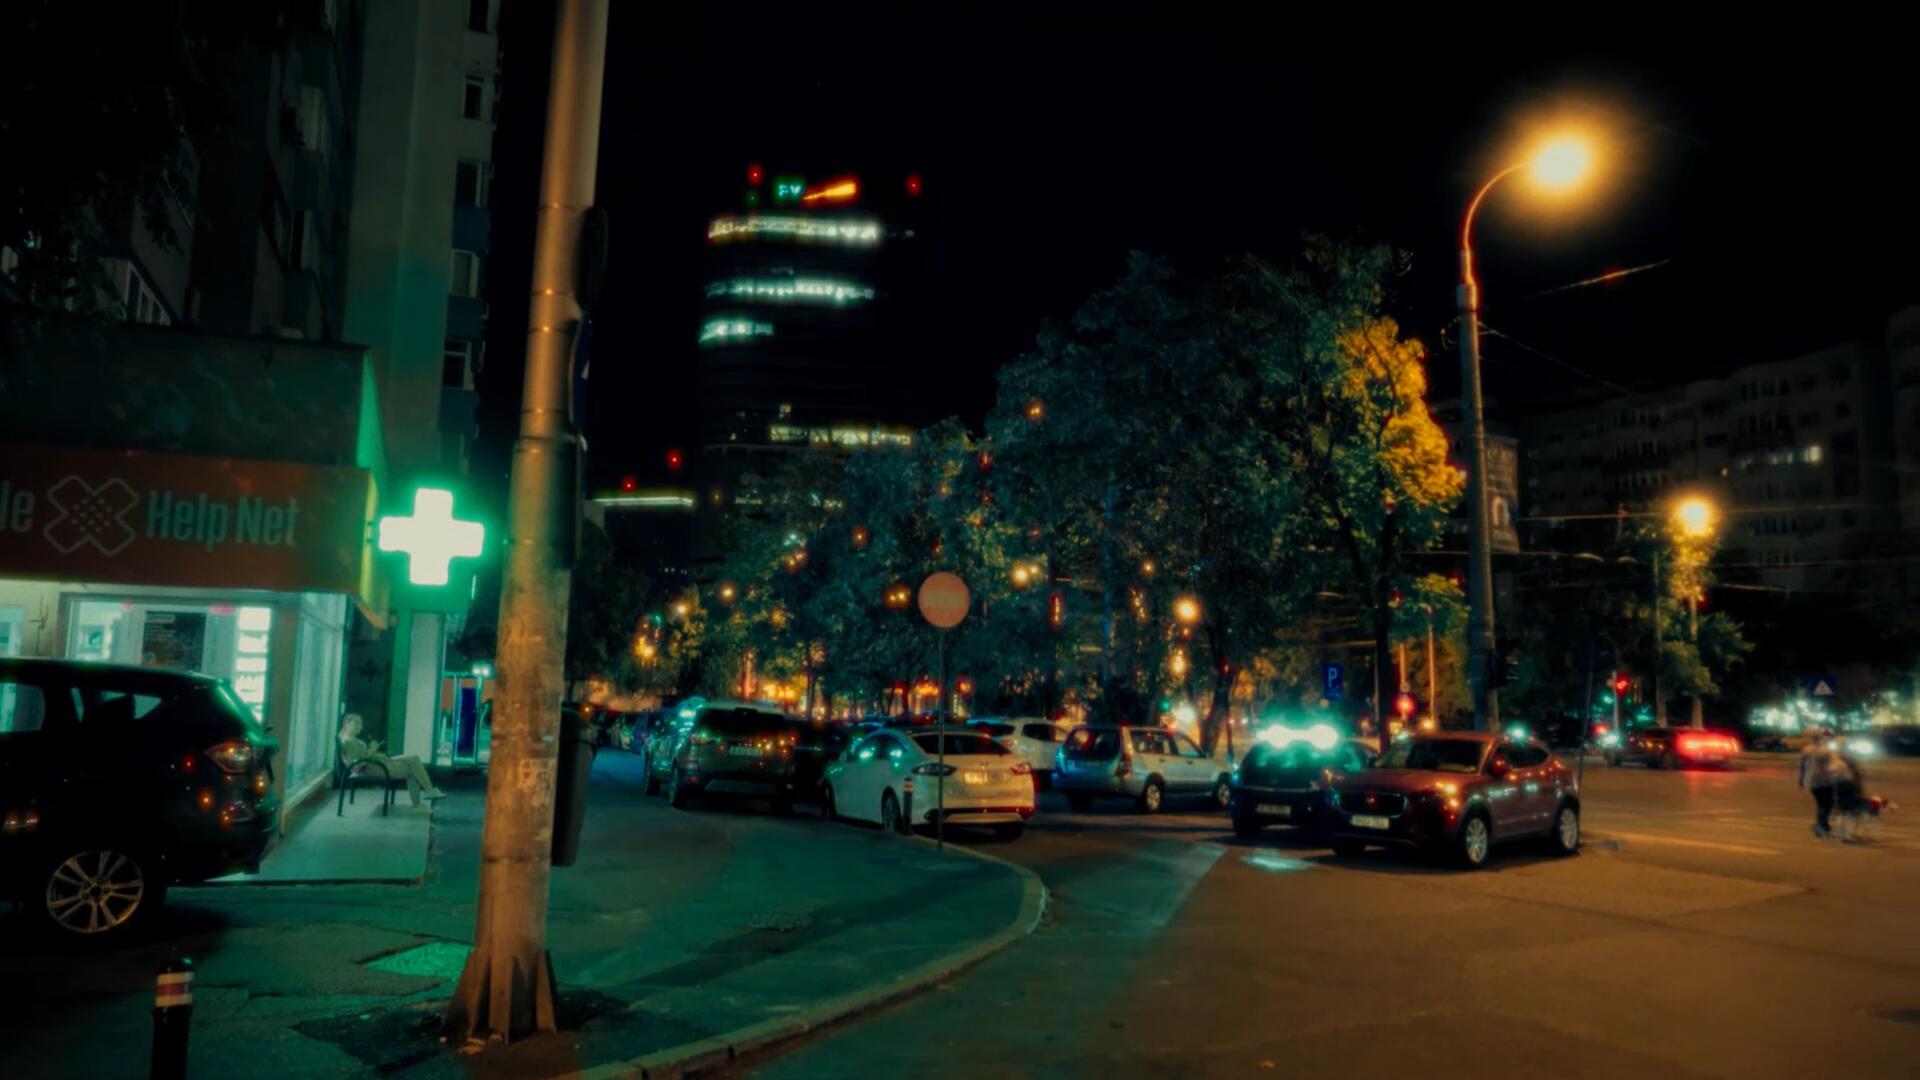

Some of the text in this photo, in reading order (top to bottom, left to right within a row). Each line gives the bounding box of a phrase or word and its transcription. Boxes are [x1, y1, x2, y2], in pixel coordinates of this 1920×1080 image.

[147, 489, 298, 552] Help Net
[1328, 666, 1338, 688] P
